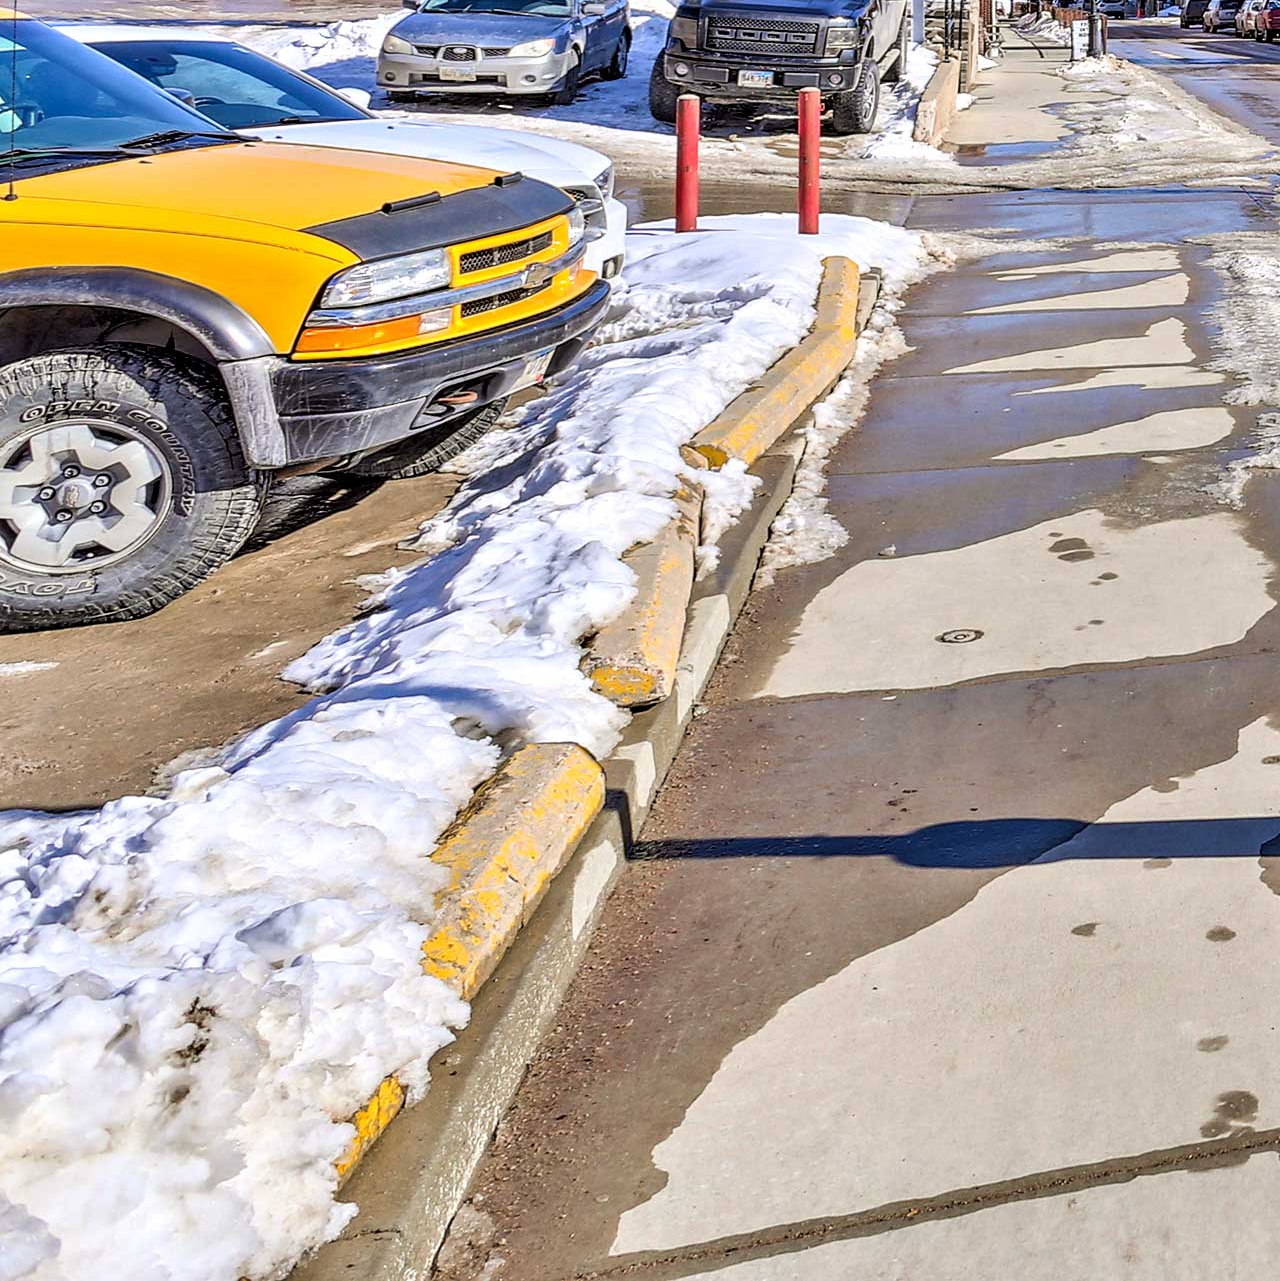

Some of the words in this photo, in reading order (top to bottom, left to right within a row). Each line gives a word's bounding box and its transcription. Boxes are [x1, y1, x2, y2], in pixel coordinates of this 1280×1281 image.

[20, 399, 120, 422] OPEN
[127, 410, 196, 517] COUNTRY
[0, 573, 97, 596] TOY
